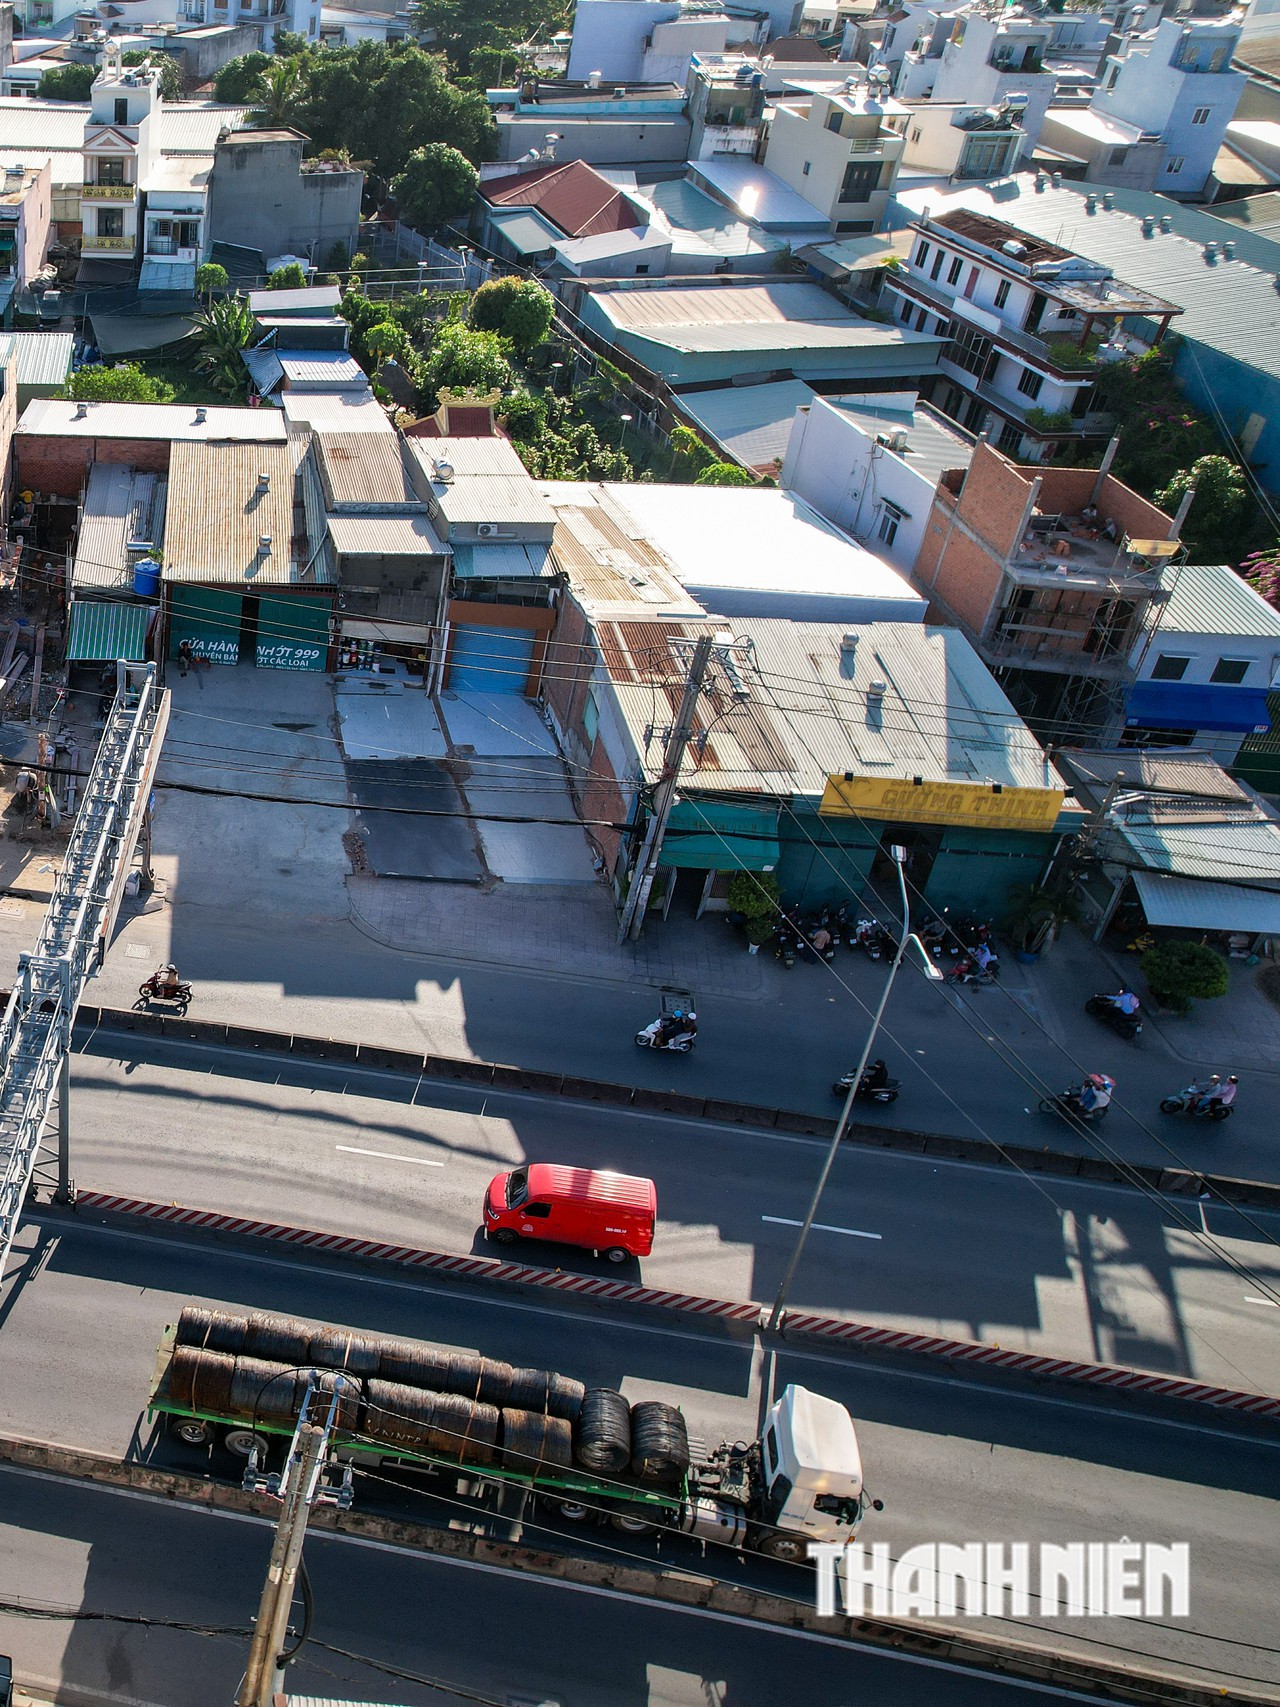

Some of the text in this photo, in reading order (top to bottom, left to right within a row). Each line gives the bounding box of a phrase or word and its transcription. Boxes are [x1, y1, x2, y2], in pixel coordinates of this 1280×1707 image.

[190, 650, 222, 660] HUYÊN
[269, 656, 287, 666] CÁC
[287, 659, 309, 668] LOẠI
[294, 648, 320, 660] 999
